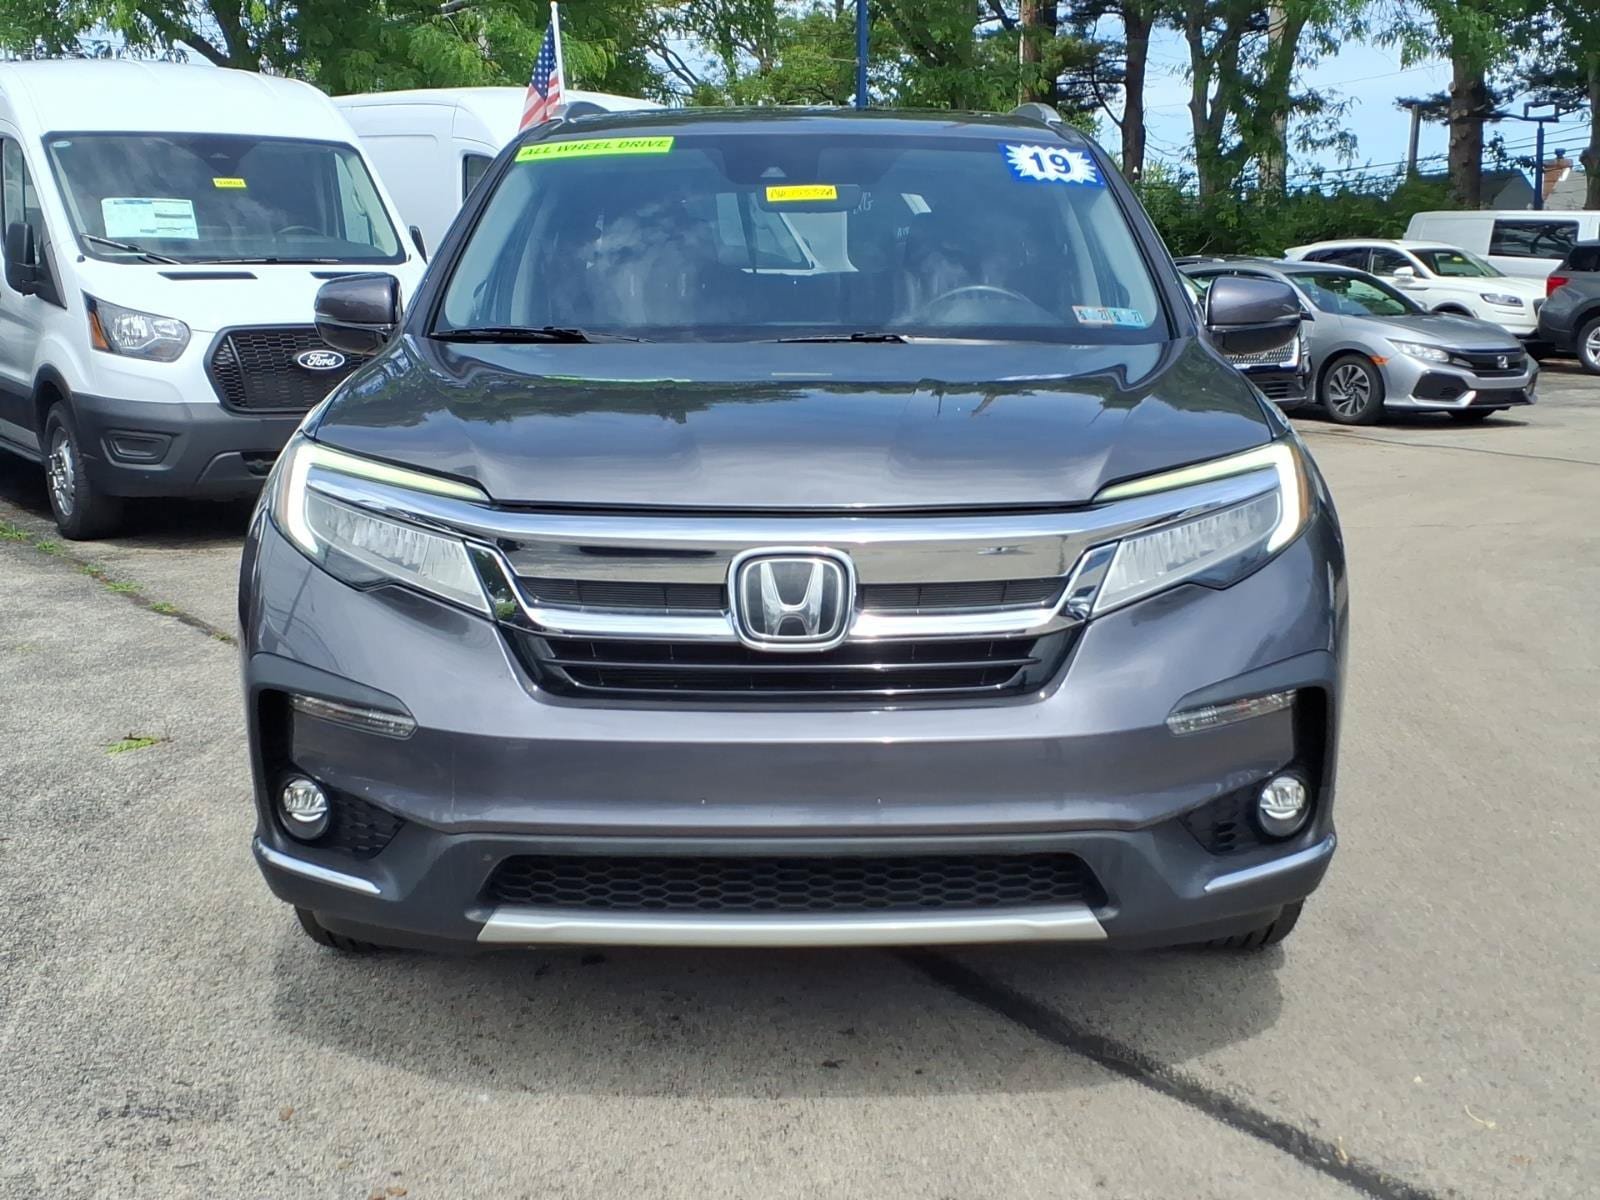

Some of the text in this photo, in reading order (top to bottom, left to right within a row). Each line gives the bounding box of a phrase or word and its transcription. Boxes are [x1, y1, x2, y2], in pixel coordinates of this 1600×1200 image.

[520, 138, 671, 157] ALL WHEEL DRIVE
[1028, 152, 1071, 174] 19
[307, 353, 336, 366] Ford
